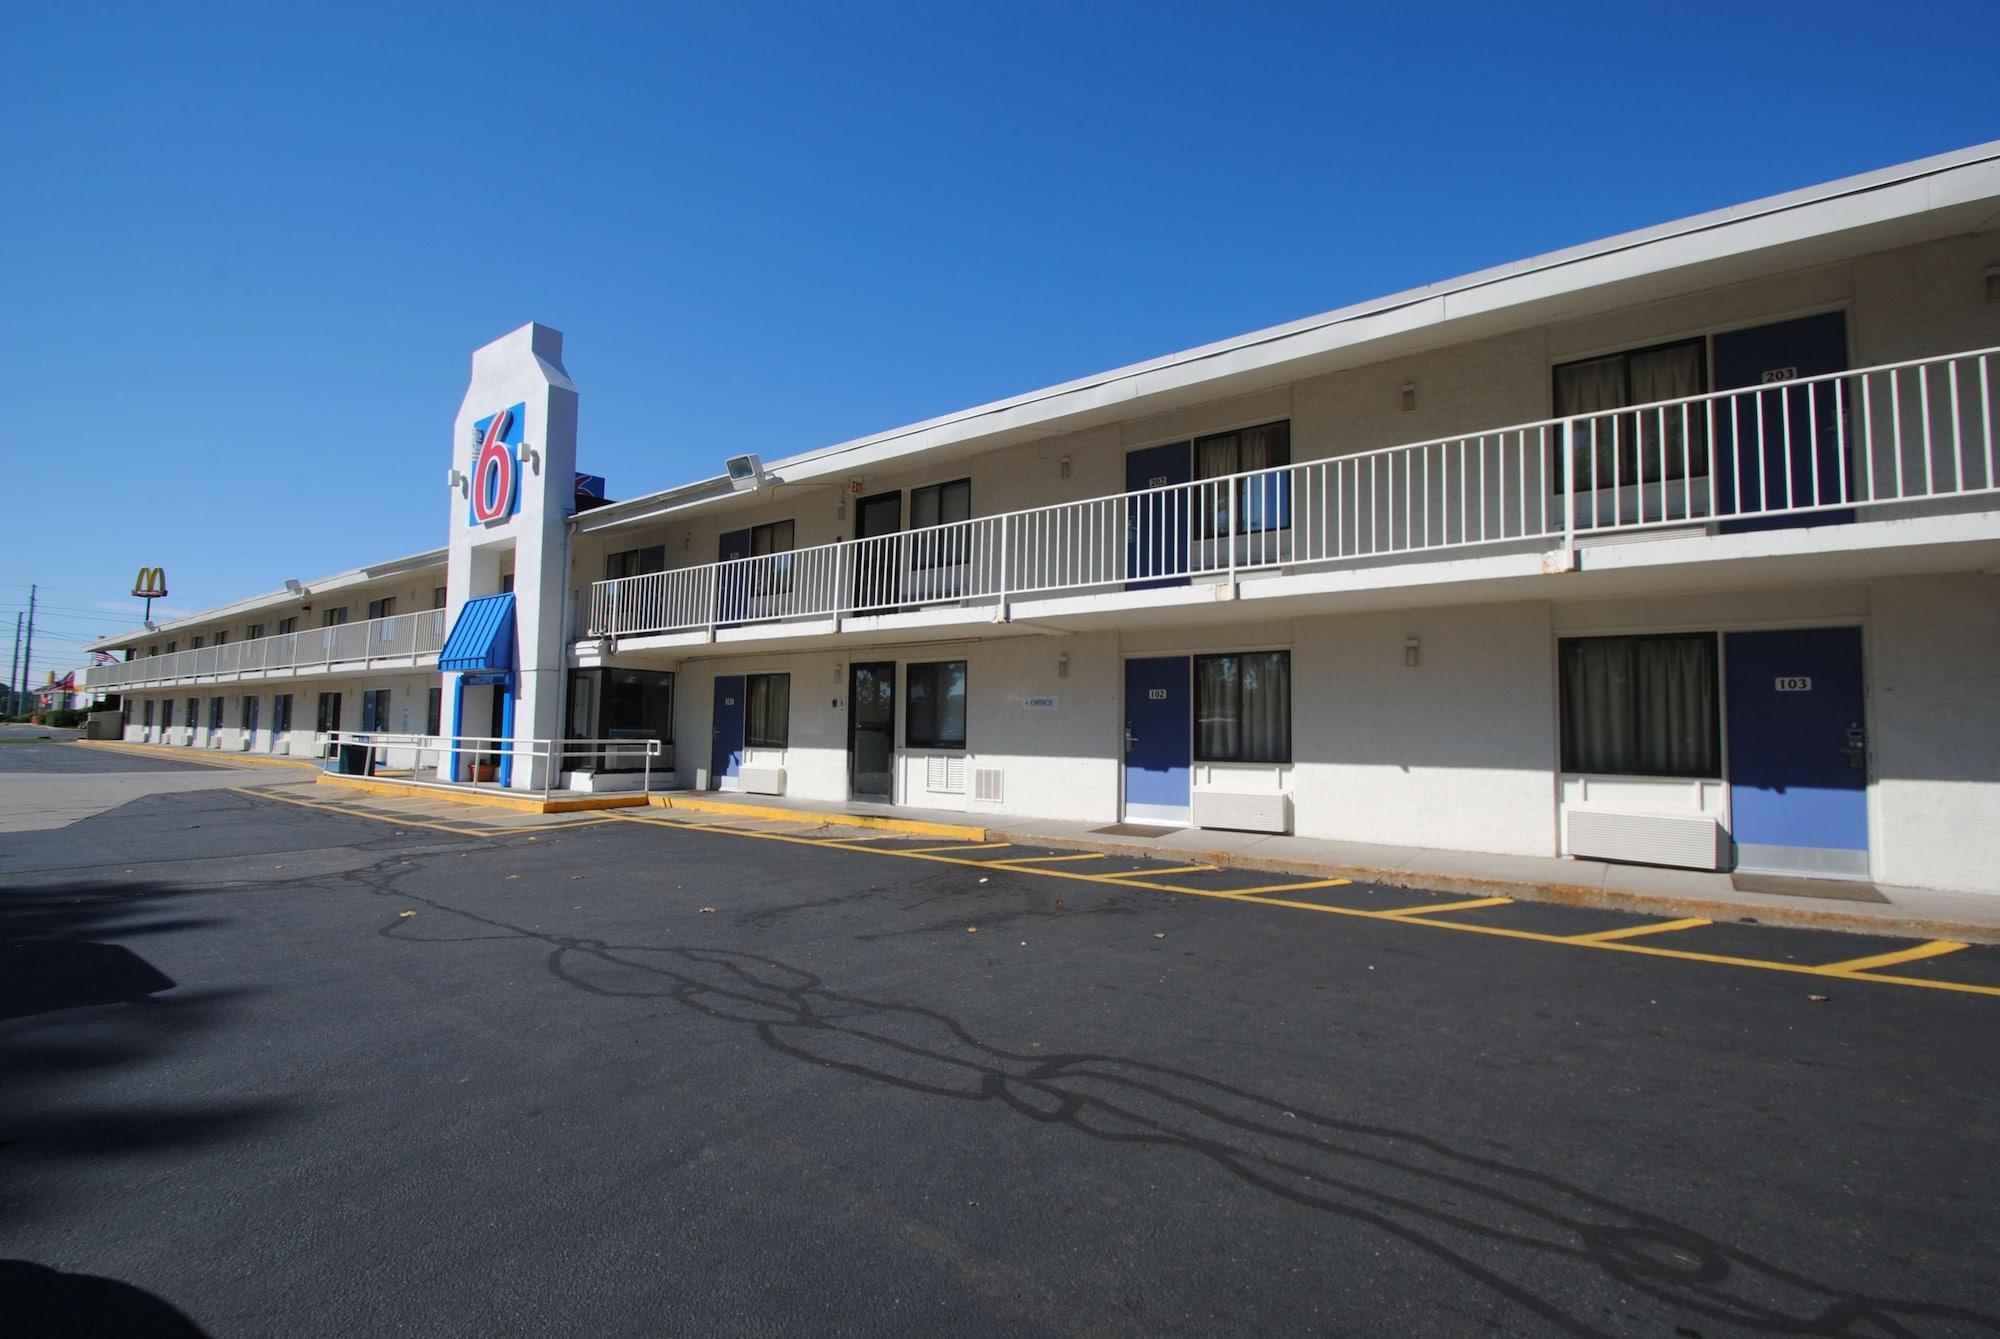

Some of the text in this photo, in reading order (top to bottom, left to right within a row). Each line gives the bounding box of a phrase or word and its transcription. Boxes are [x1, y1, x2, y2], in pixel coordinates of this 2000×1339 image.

[1766, 368, 1794, 382] 203
[474, 408, 513, 524] 6
[1779, 678, 1807, 689] 103
[1151, 690, 1164, 698] 102
